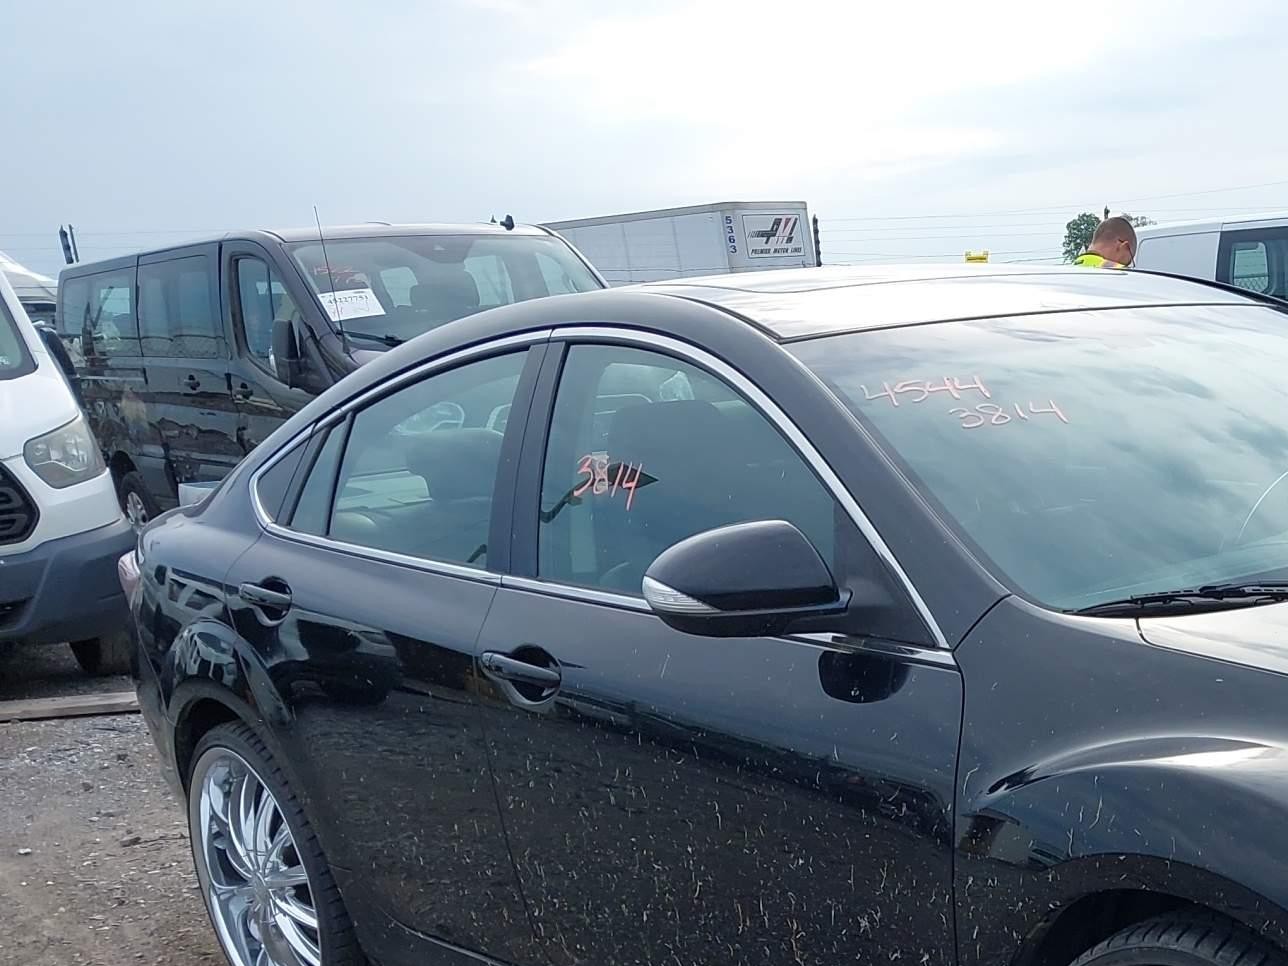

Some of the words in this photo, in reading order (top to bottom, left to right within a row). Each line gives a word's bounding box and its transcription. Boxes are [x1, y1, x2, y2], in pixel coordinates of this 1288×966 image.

[725, 216, 737, 254] 5363
[860, 375, 991, 407] 4544
[949, 399, 1069, 429] 3814
[573, 454, 643, 512] 3814
